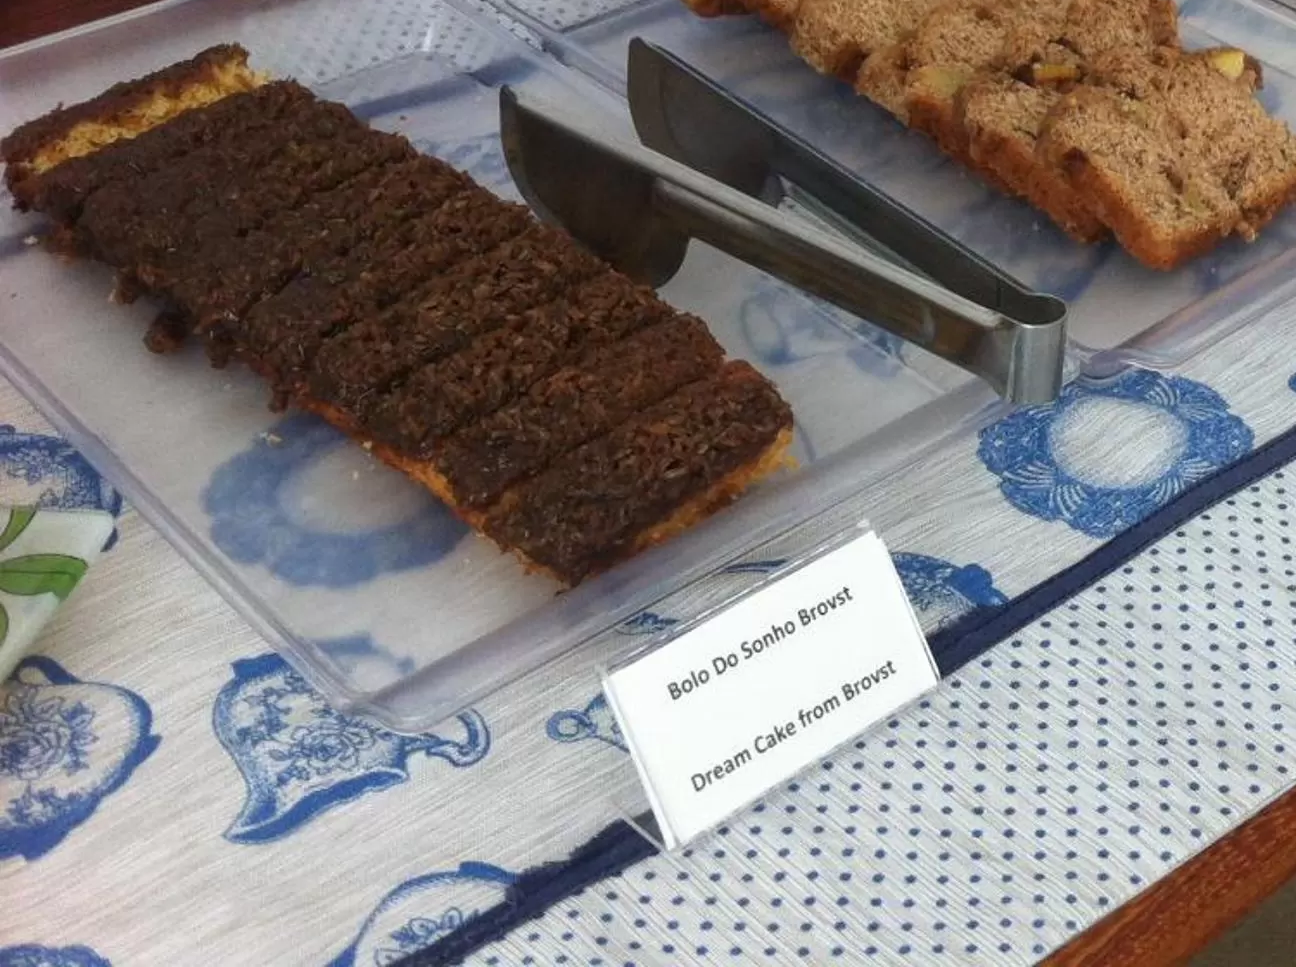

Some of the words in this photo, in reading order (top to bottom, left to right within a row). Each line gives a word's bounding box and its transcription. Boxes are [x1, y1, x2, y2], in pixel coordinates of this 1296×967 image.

[667, 669, 710, 701] Bolo
[712, 651, 739, 677] Do
[741, 618, 796, 660] Sonho
[797, 586, 853, 627] Brovst
[691, 747, 752, 792] Dream
[754, 718, 797, 754] Cake
[798, 696, 841, 728] from
[842, 660, 897, 702] Brovst
